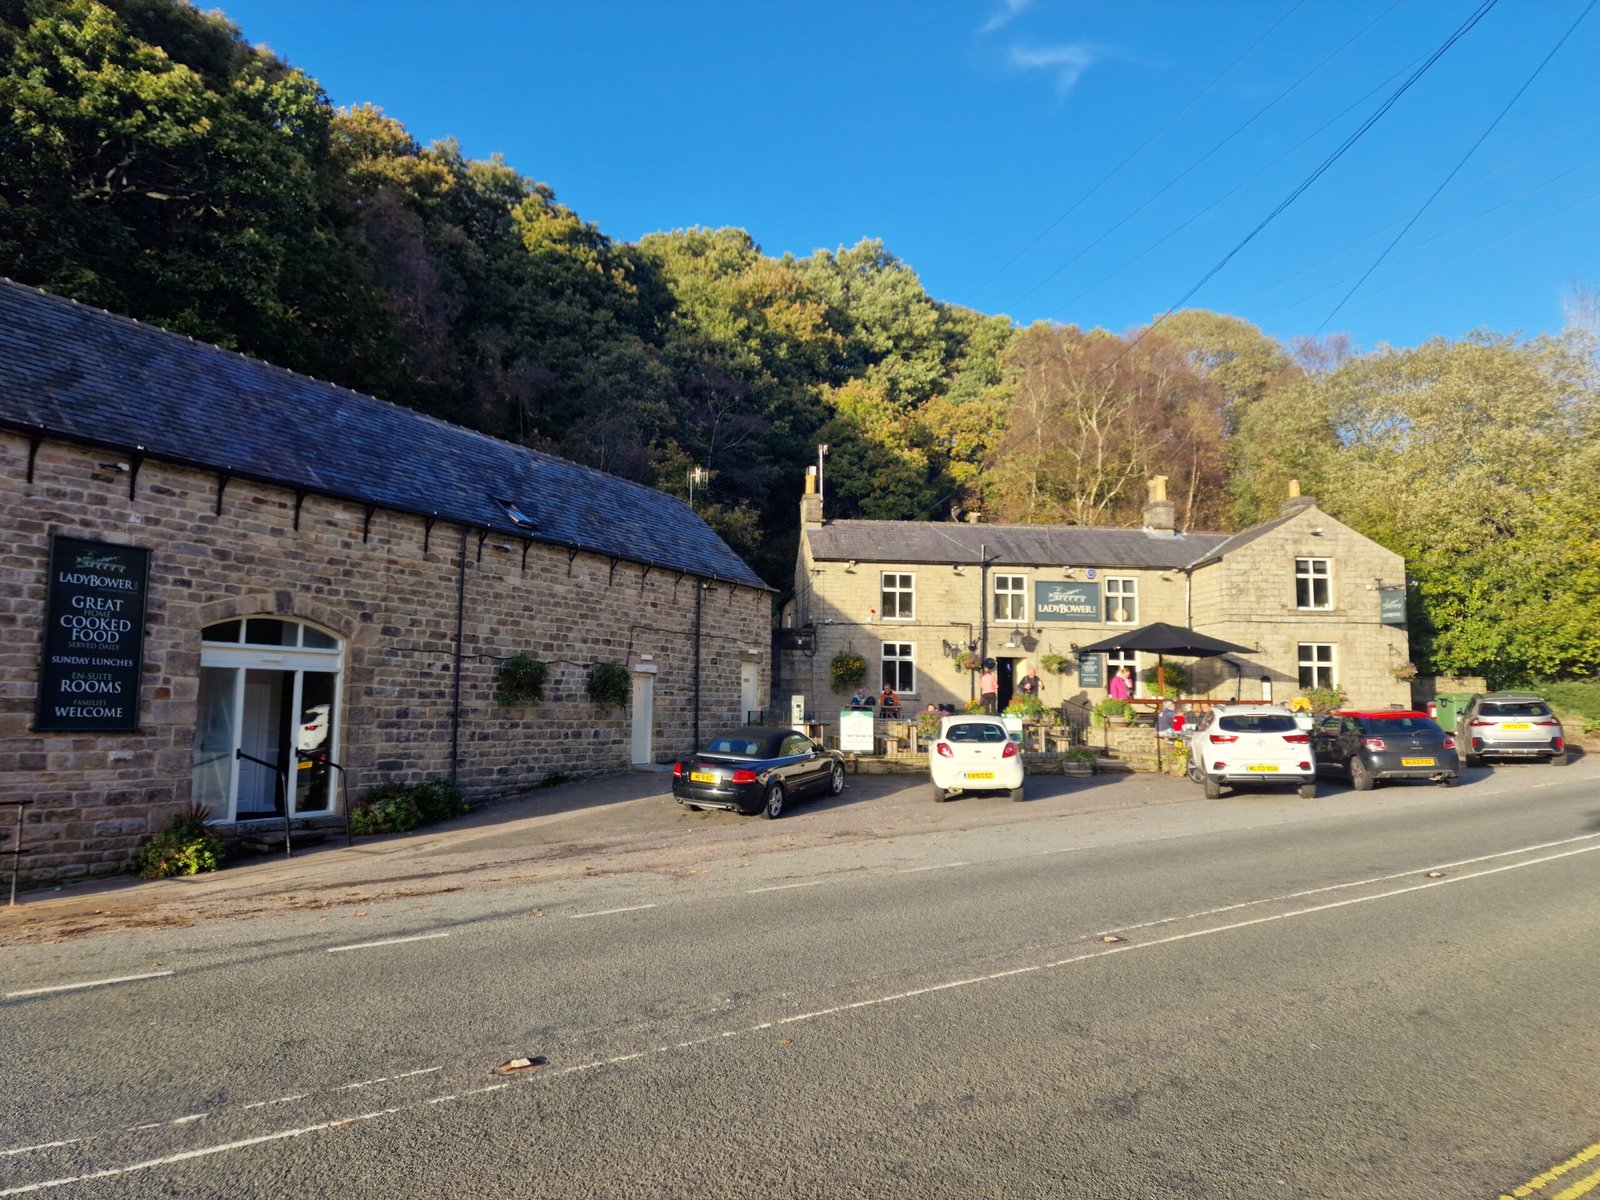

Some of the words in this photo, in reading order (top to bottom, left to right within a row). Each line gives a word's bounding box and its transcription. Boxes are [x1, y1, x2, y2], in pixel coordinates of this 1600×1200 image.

[59, 572, 133, 590] LADYBOWER
[71, 595, 124, 612] GREAT
[1038, 603, 1092, 614] LADYBOWER
[83, 608, 112, 618] HOME
[60, 614, 131, 632] COOKED
[72, 628, 120, 643] FOOD
[68, 641, 97, 650] SERVED
[98, 643, 120, 651] DAILY
[51, 655, 90, 665] SUNDAY
[92, 657, 133, 667] LUNCHES
[71, 671, 113, 681] EN-SUITE
[60, 679, 122, 694] ROOMS
[73, 699, 107, 707] FAMILIES
[55, 706, 124, 718] WELCOME
